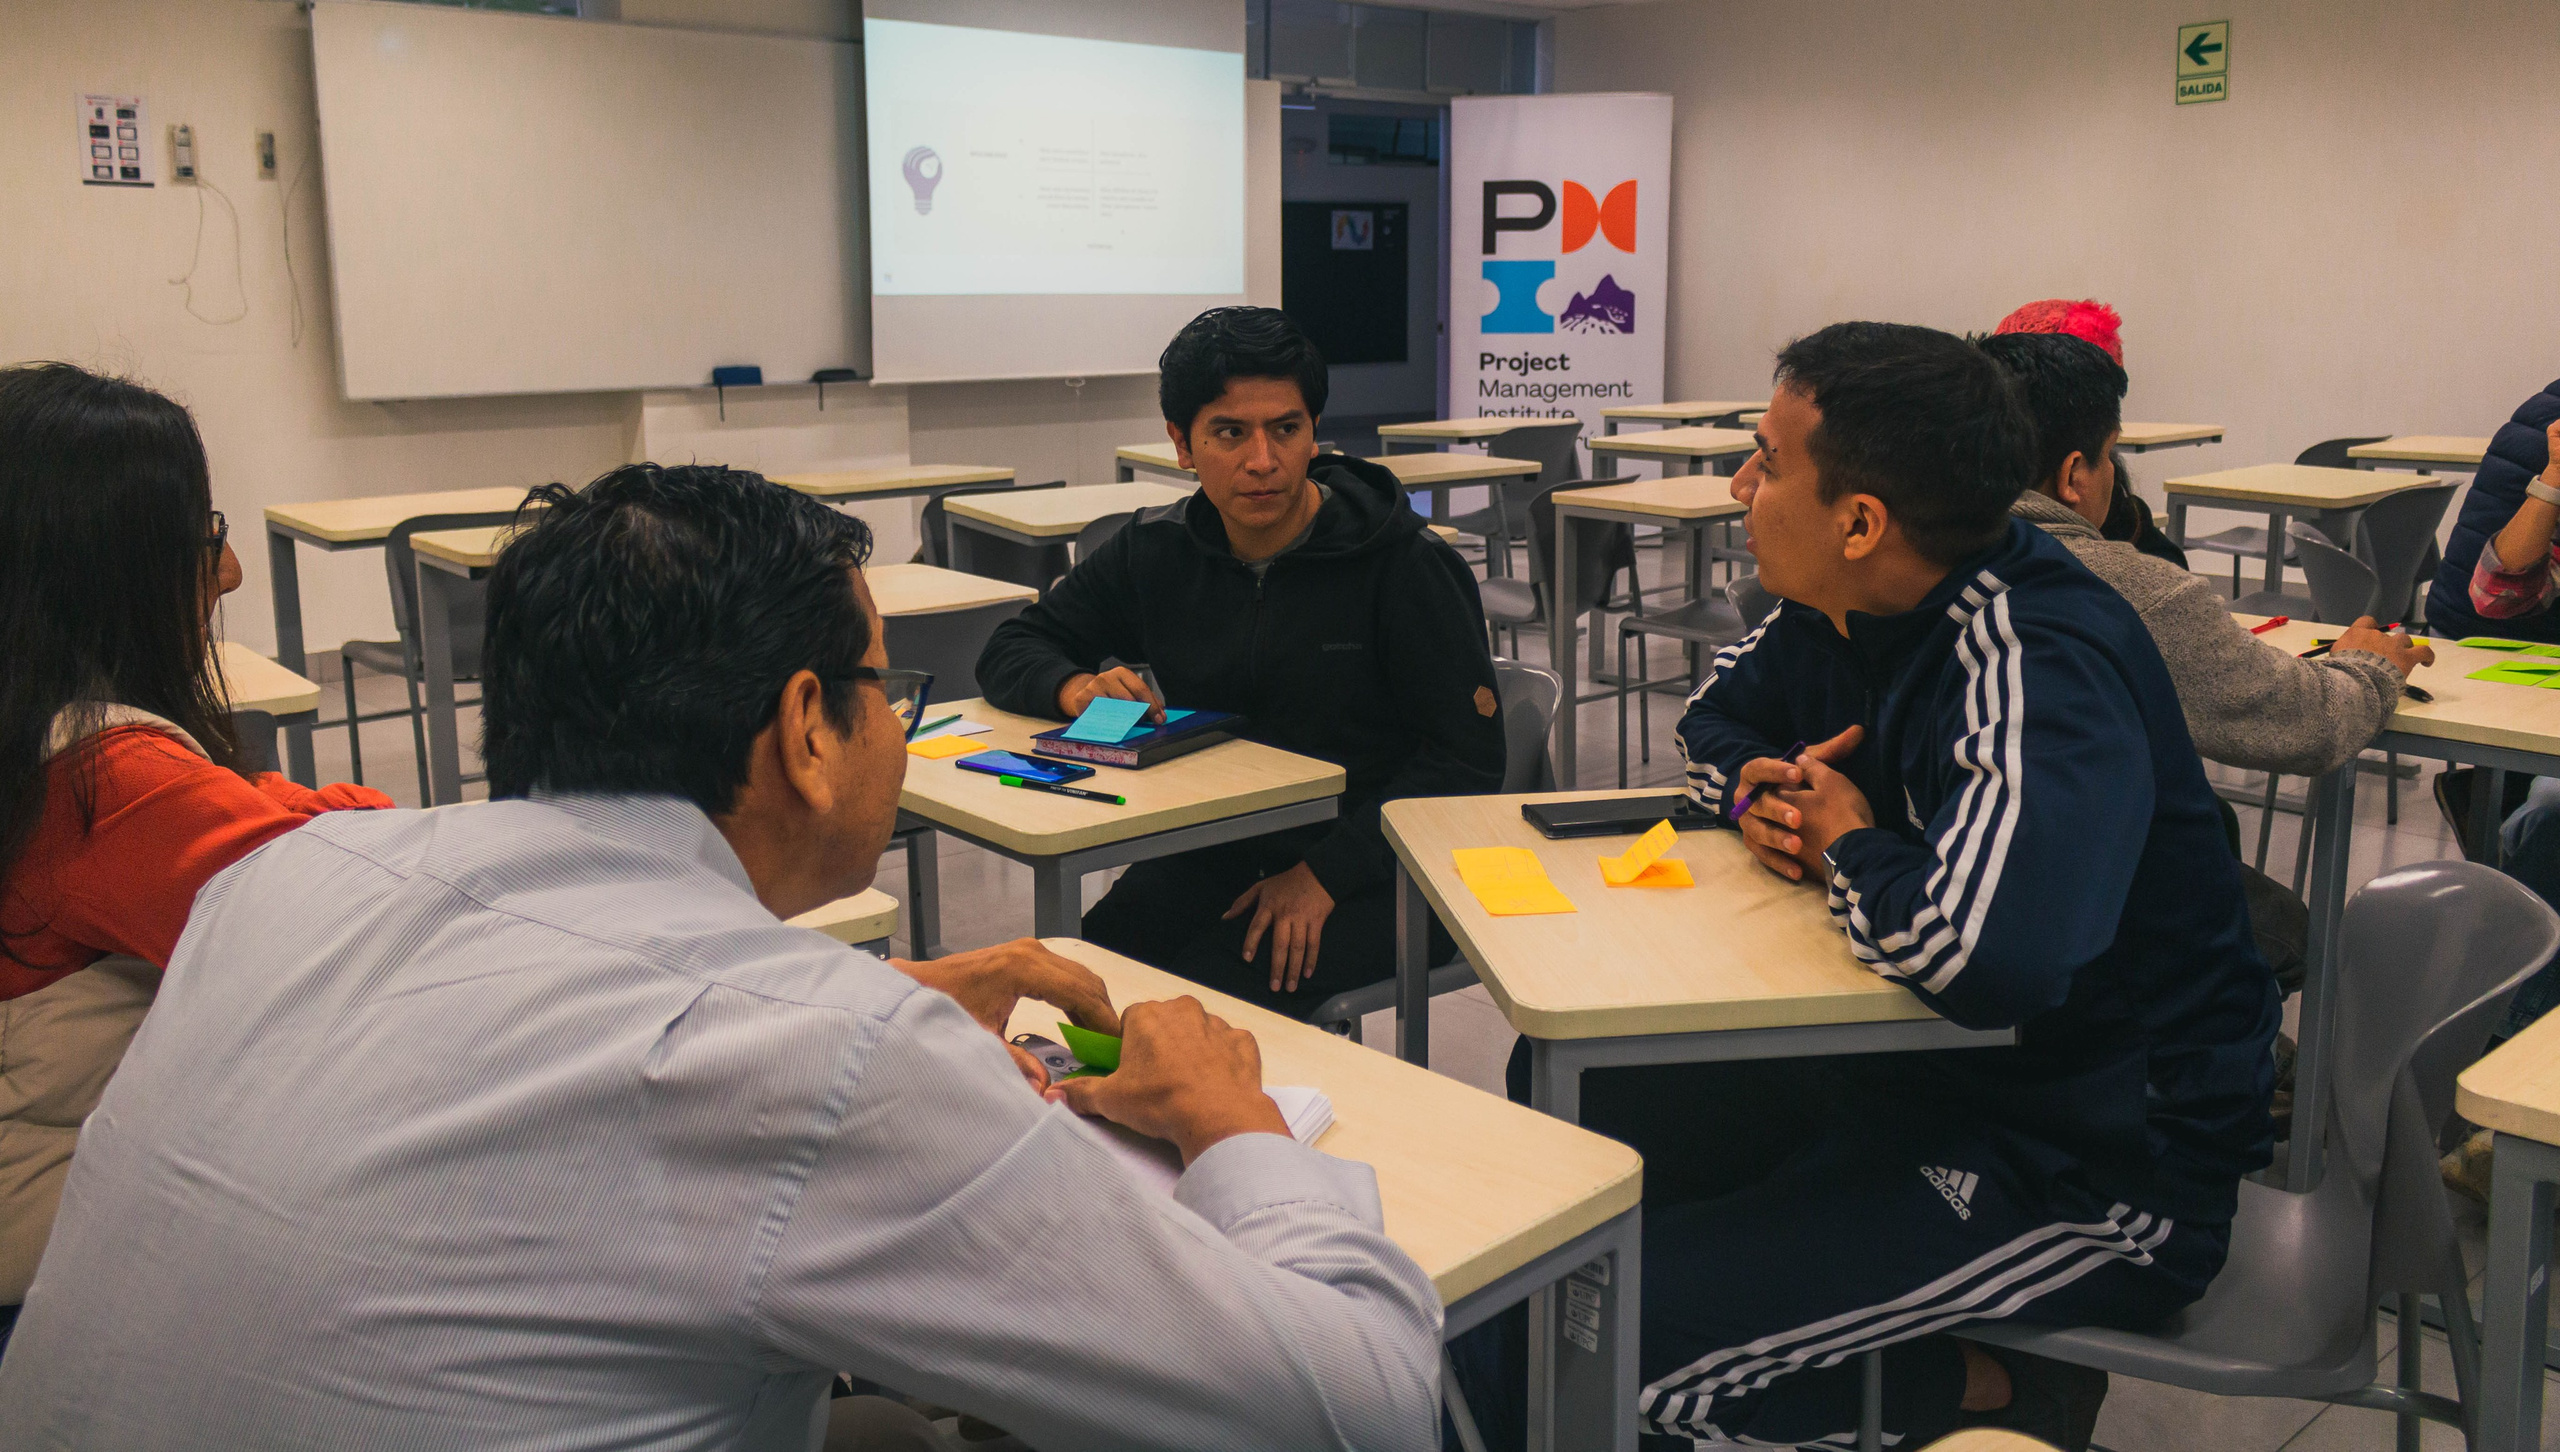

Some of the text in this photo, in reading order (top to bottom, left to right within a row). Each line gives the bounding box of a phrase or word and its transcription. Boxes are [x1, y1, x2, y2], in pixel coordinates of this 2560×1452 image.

[2180, 82, 2222, 97] SALIDA
[1480, 352, 1570, 376] Project
[1479, 379, 1633, 403] Management
[1920, 1166, 1971, 1220] adidas
